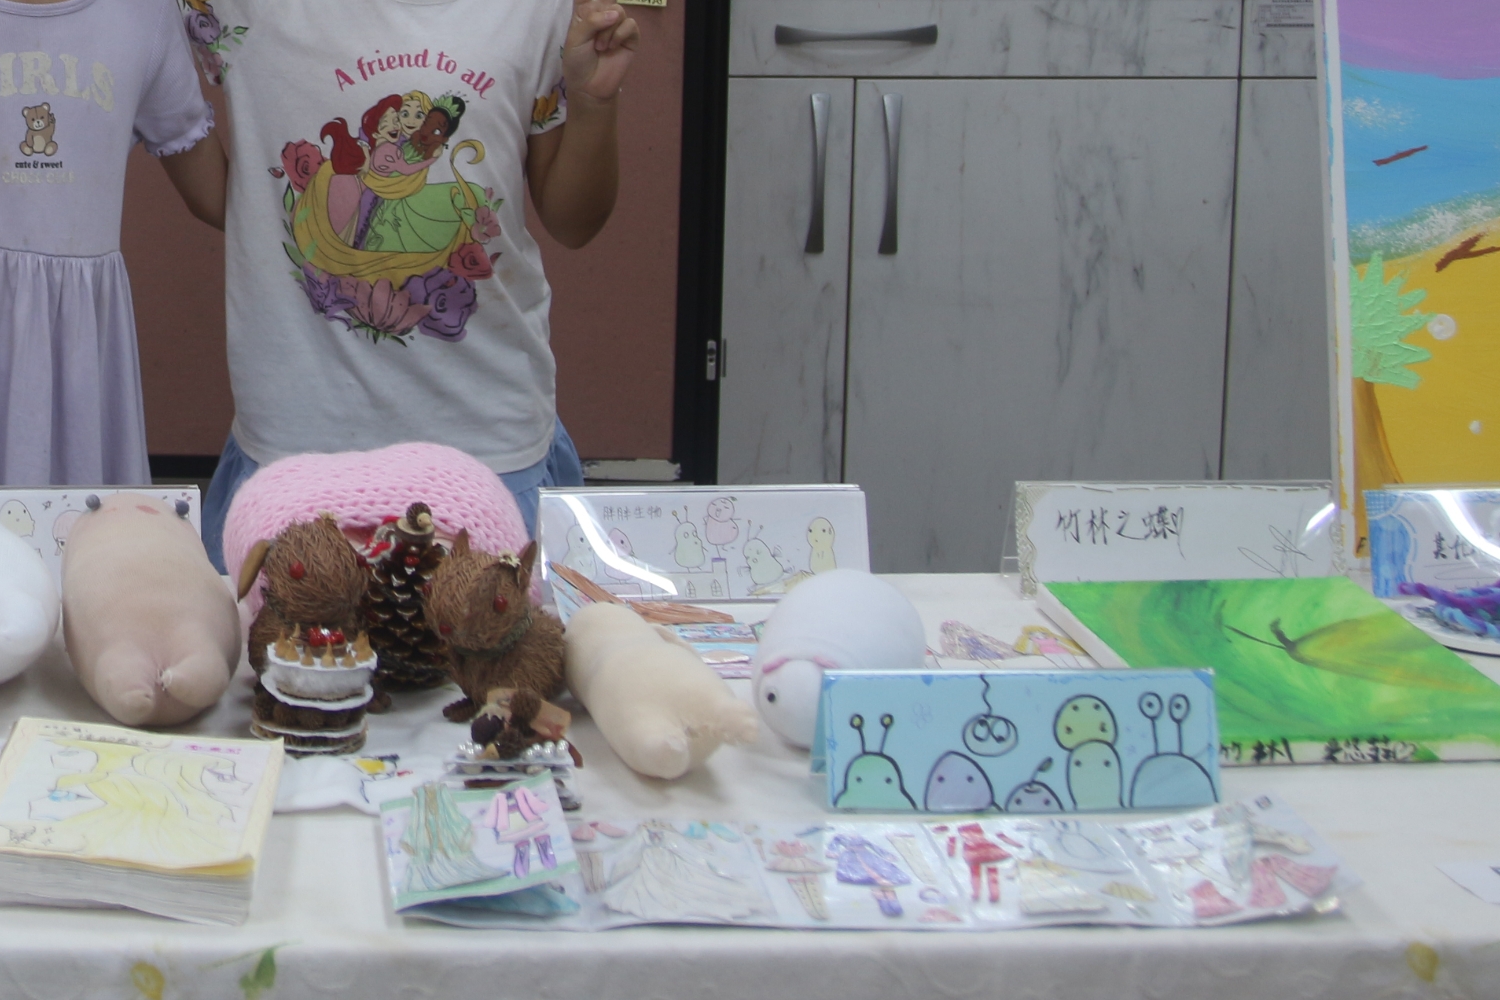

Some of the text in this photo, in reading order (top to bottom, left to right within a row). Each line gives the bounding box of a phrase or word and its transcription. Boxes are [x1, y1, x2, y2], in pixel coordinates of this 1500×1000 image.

[335, 49, 495, 99] A friend to all
[15, 160, 63, 169] cute & sweet
[603, 506, 662, 521] 胖胖生物
